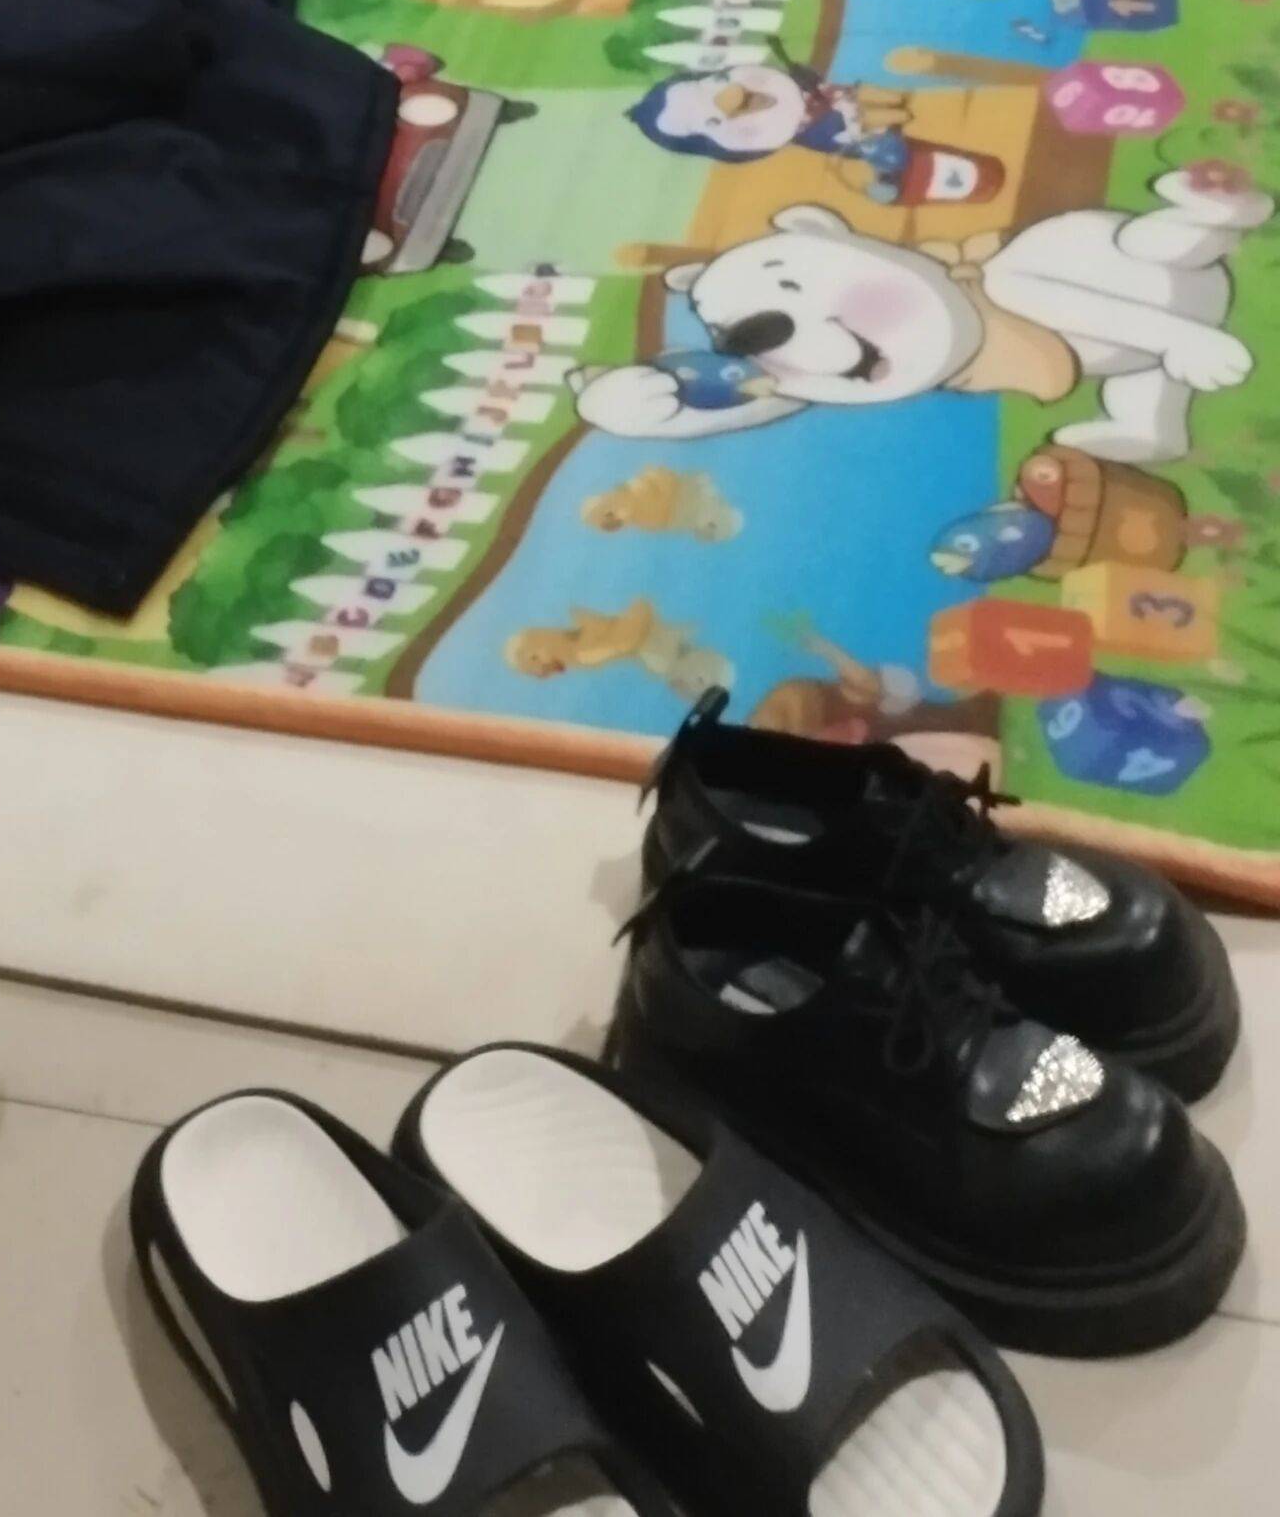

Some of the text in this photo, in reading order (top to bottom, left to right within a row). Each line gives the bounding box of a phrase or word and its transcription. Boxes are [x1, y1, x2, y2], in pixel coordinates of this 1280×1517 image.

[1003, 626, 1074, 656] 1
[1130, 593, 1195, 629] 3
[697, 1199, 796, 1342] NIKE
[370, 1282, 483, 1423] NIKE
